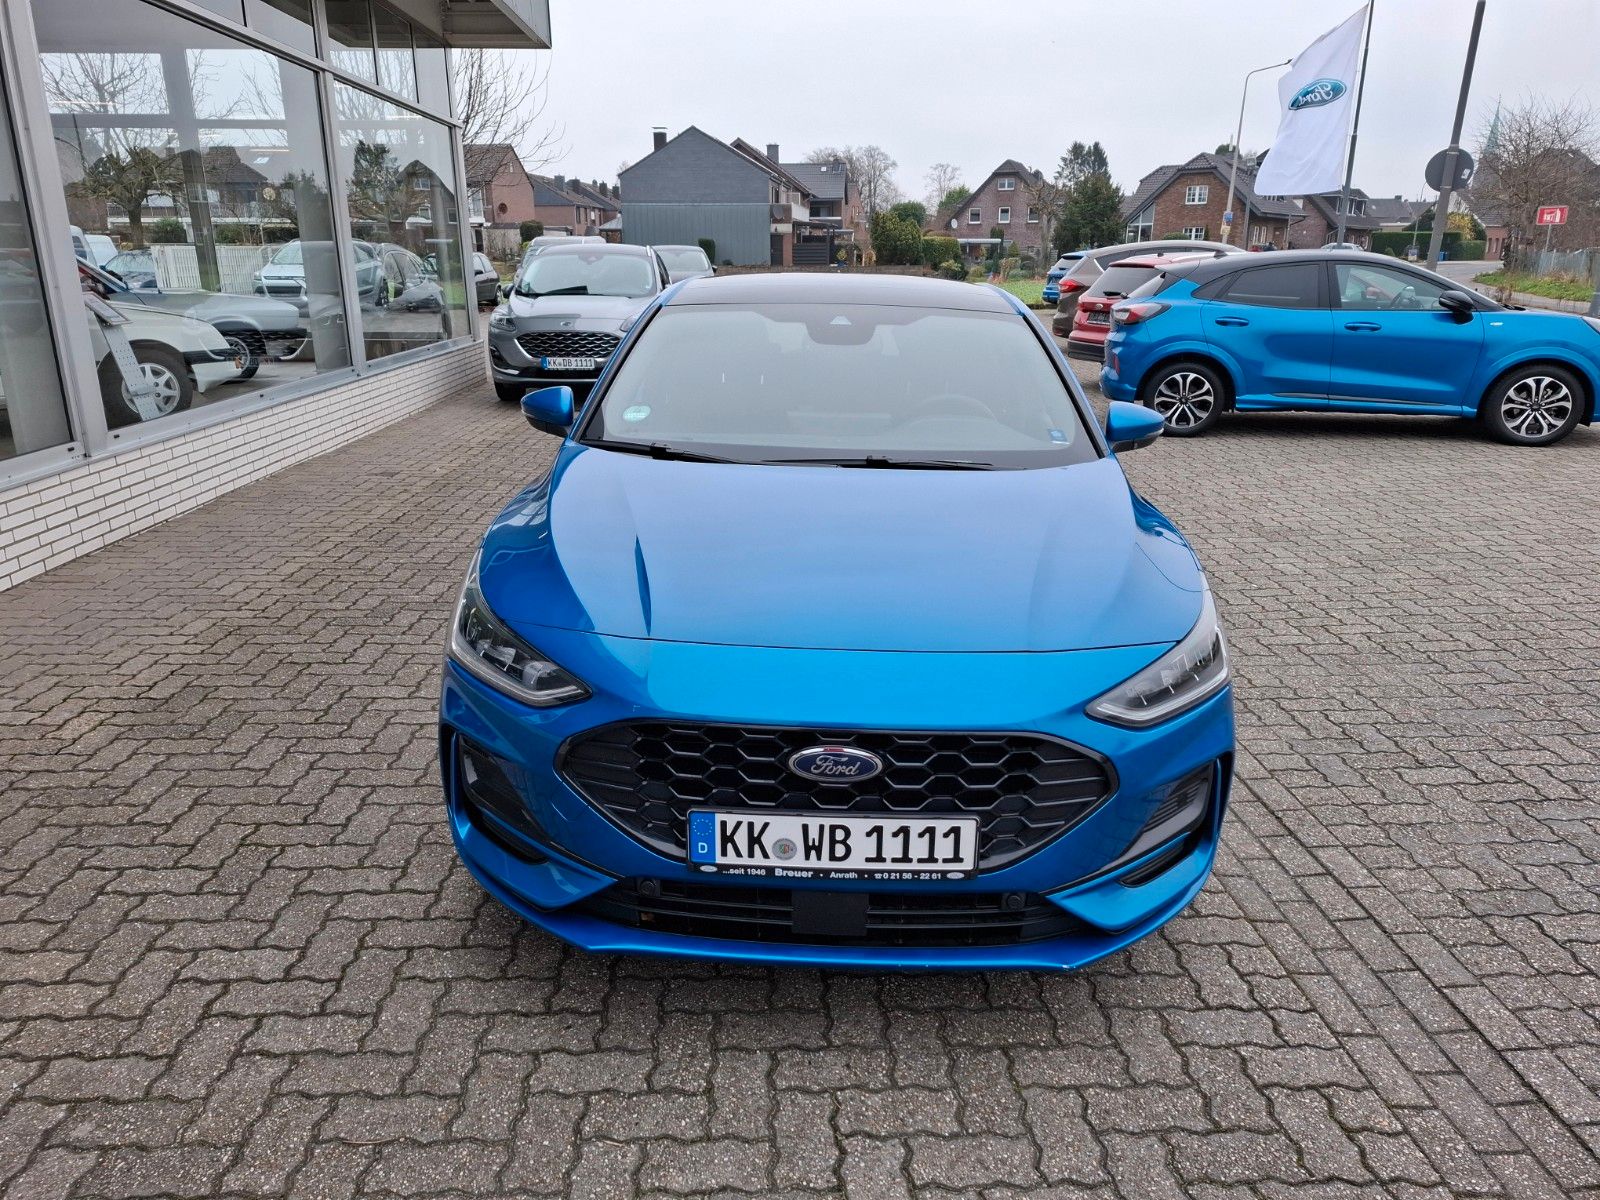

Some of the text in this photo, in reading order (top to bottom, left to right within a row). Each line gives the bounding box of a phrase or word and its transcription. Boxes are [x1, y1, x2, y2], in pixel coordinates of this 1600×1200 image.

[547, 358, 558, 367] KK
[574, 358, 593, 367] 1111
[810, 755, 861, 775] Ford
[698, 842, 708, 854] D
[720, 820, 771, 860] KK
[801, 823, 852, 862] WB
[864, 824, 965, 864] 1111
[746, 868, 766, 876] 1946
[774, 867, 814, 878] Breuer
[829, 871, 858, 879] Anrath
